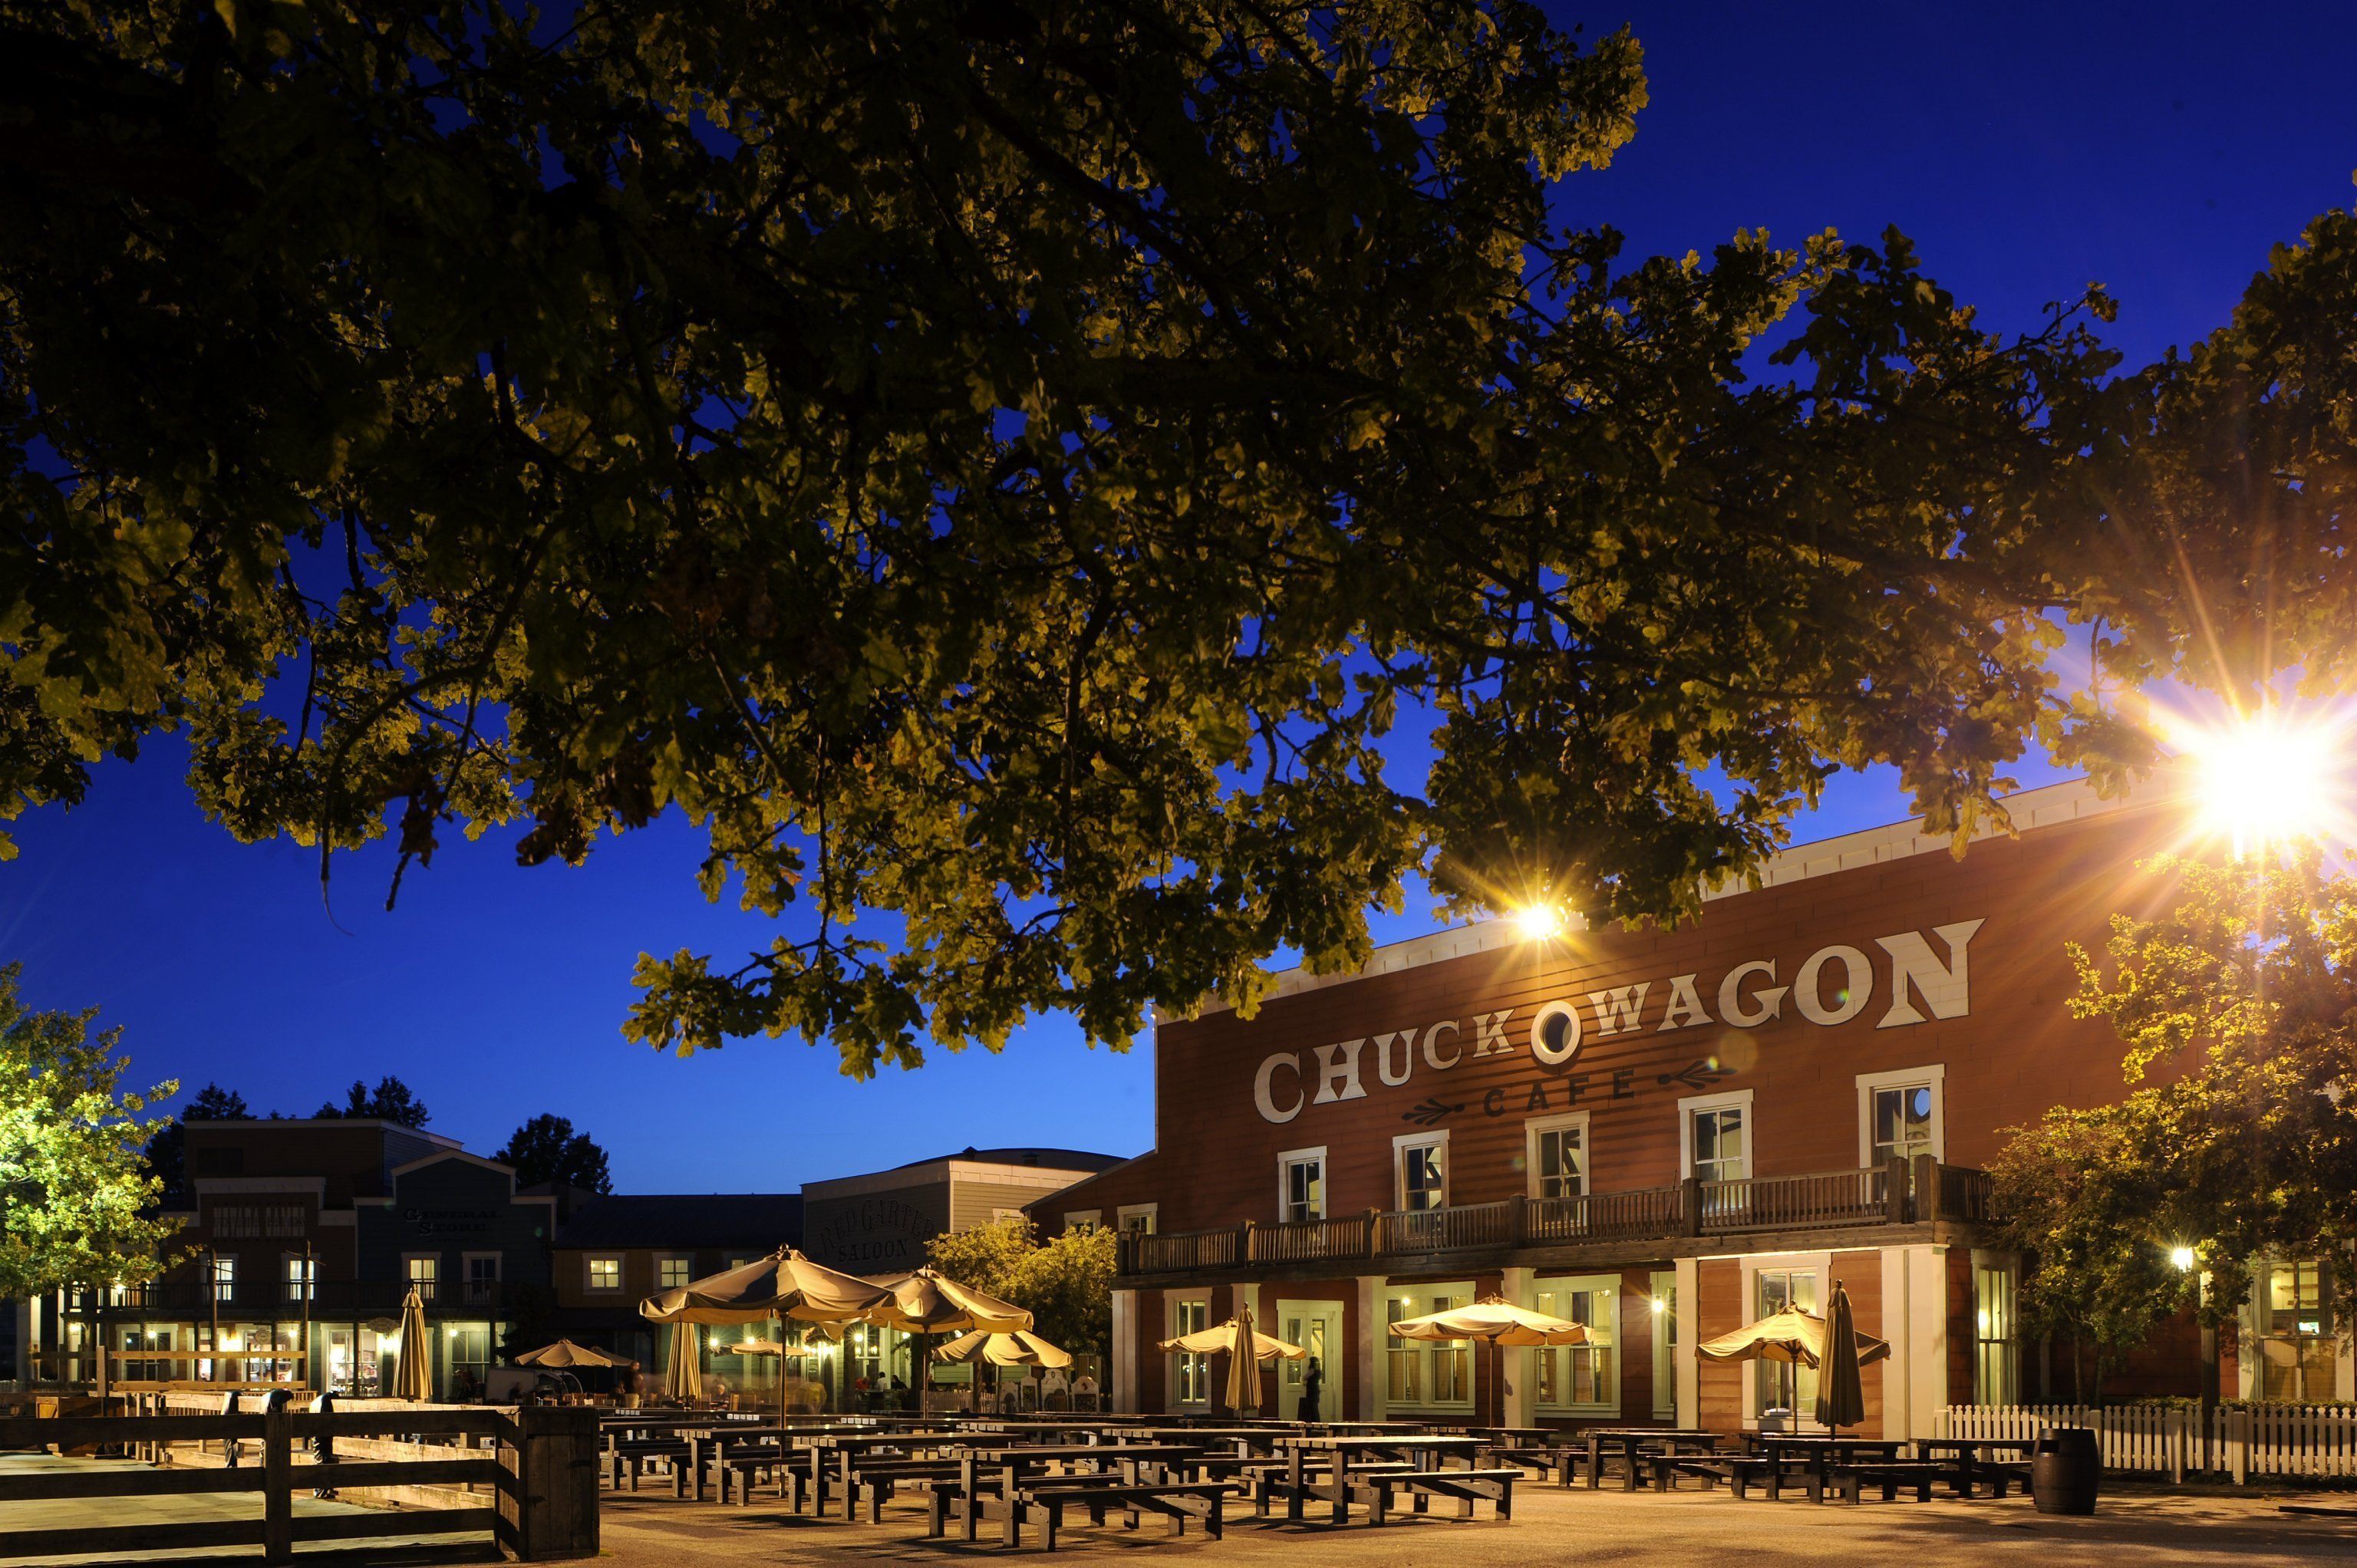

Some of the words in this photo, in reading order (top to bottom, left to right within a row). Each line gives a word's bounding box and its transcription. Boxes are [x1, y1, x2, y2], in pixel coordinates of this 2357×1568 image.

[1254, 1009, 1516, 1124] CHUCK
[1587, 917, 1987, 1037] WAGON
[1484, 1067, 1637, 1118] CAFE
[404, 1207, 503, 1222] GENERAL
[418, 1221, 486, 1236] STORE
[819, 1208, 857, 1257] RED
[861, 1198, 935, 1242] GARTER
[838, 1238, 908, 1263] SALOON
